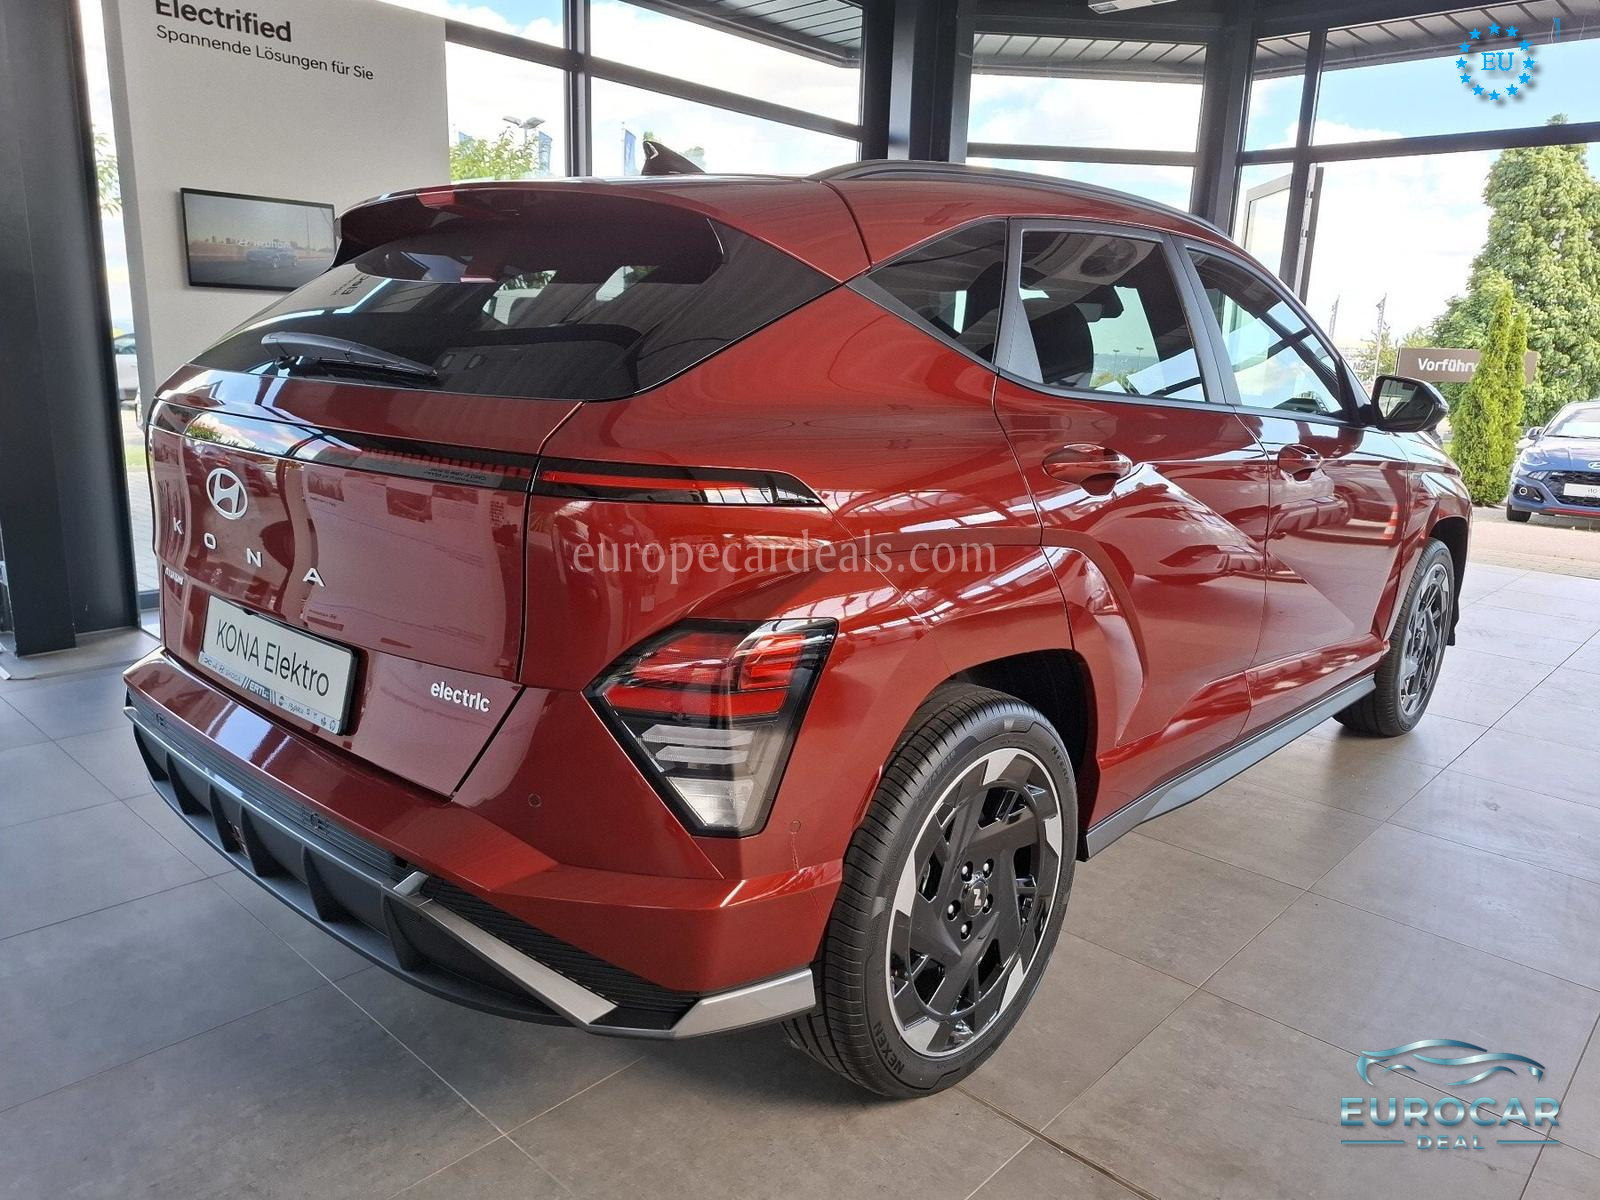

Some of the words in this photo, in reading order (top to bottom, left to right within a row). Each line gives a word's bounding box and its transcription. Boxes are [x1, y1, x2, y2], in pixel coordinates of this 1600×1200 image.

[155, 0, 292, 42] Electrified
[156, 25, 251, 56] Spannende
[256, 45, 328, 72] Lösungen
[332, 61, 350, 76] für
[353, 65, 374, 80] Sie
[216, 619, 260, 668] KONA
[264, 642, 329, 697] Elektro
[430, 680, 491, 713] electric
[873, 1020, 905, 1075] NEXEN
